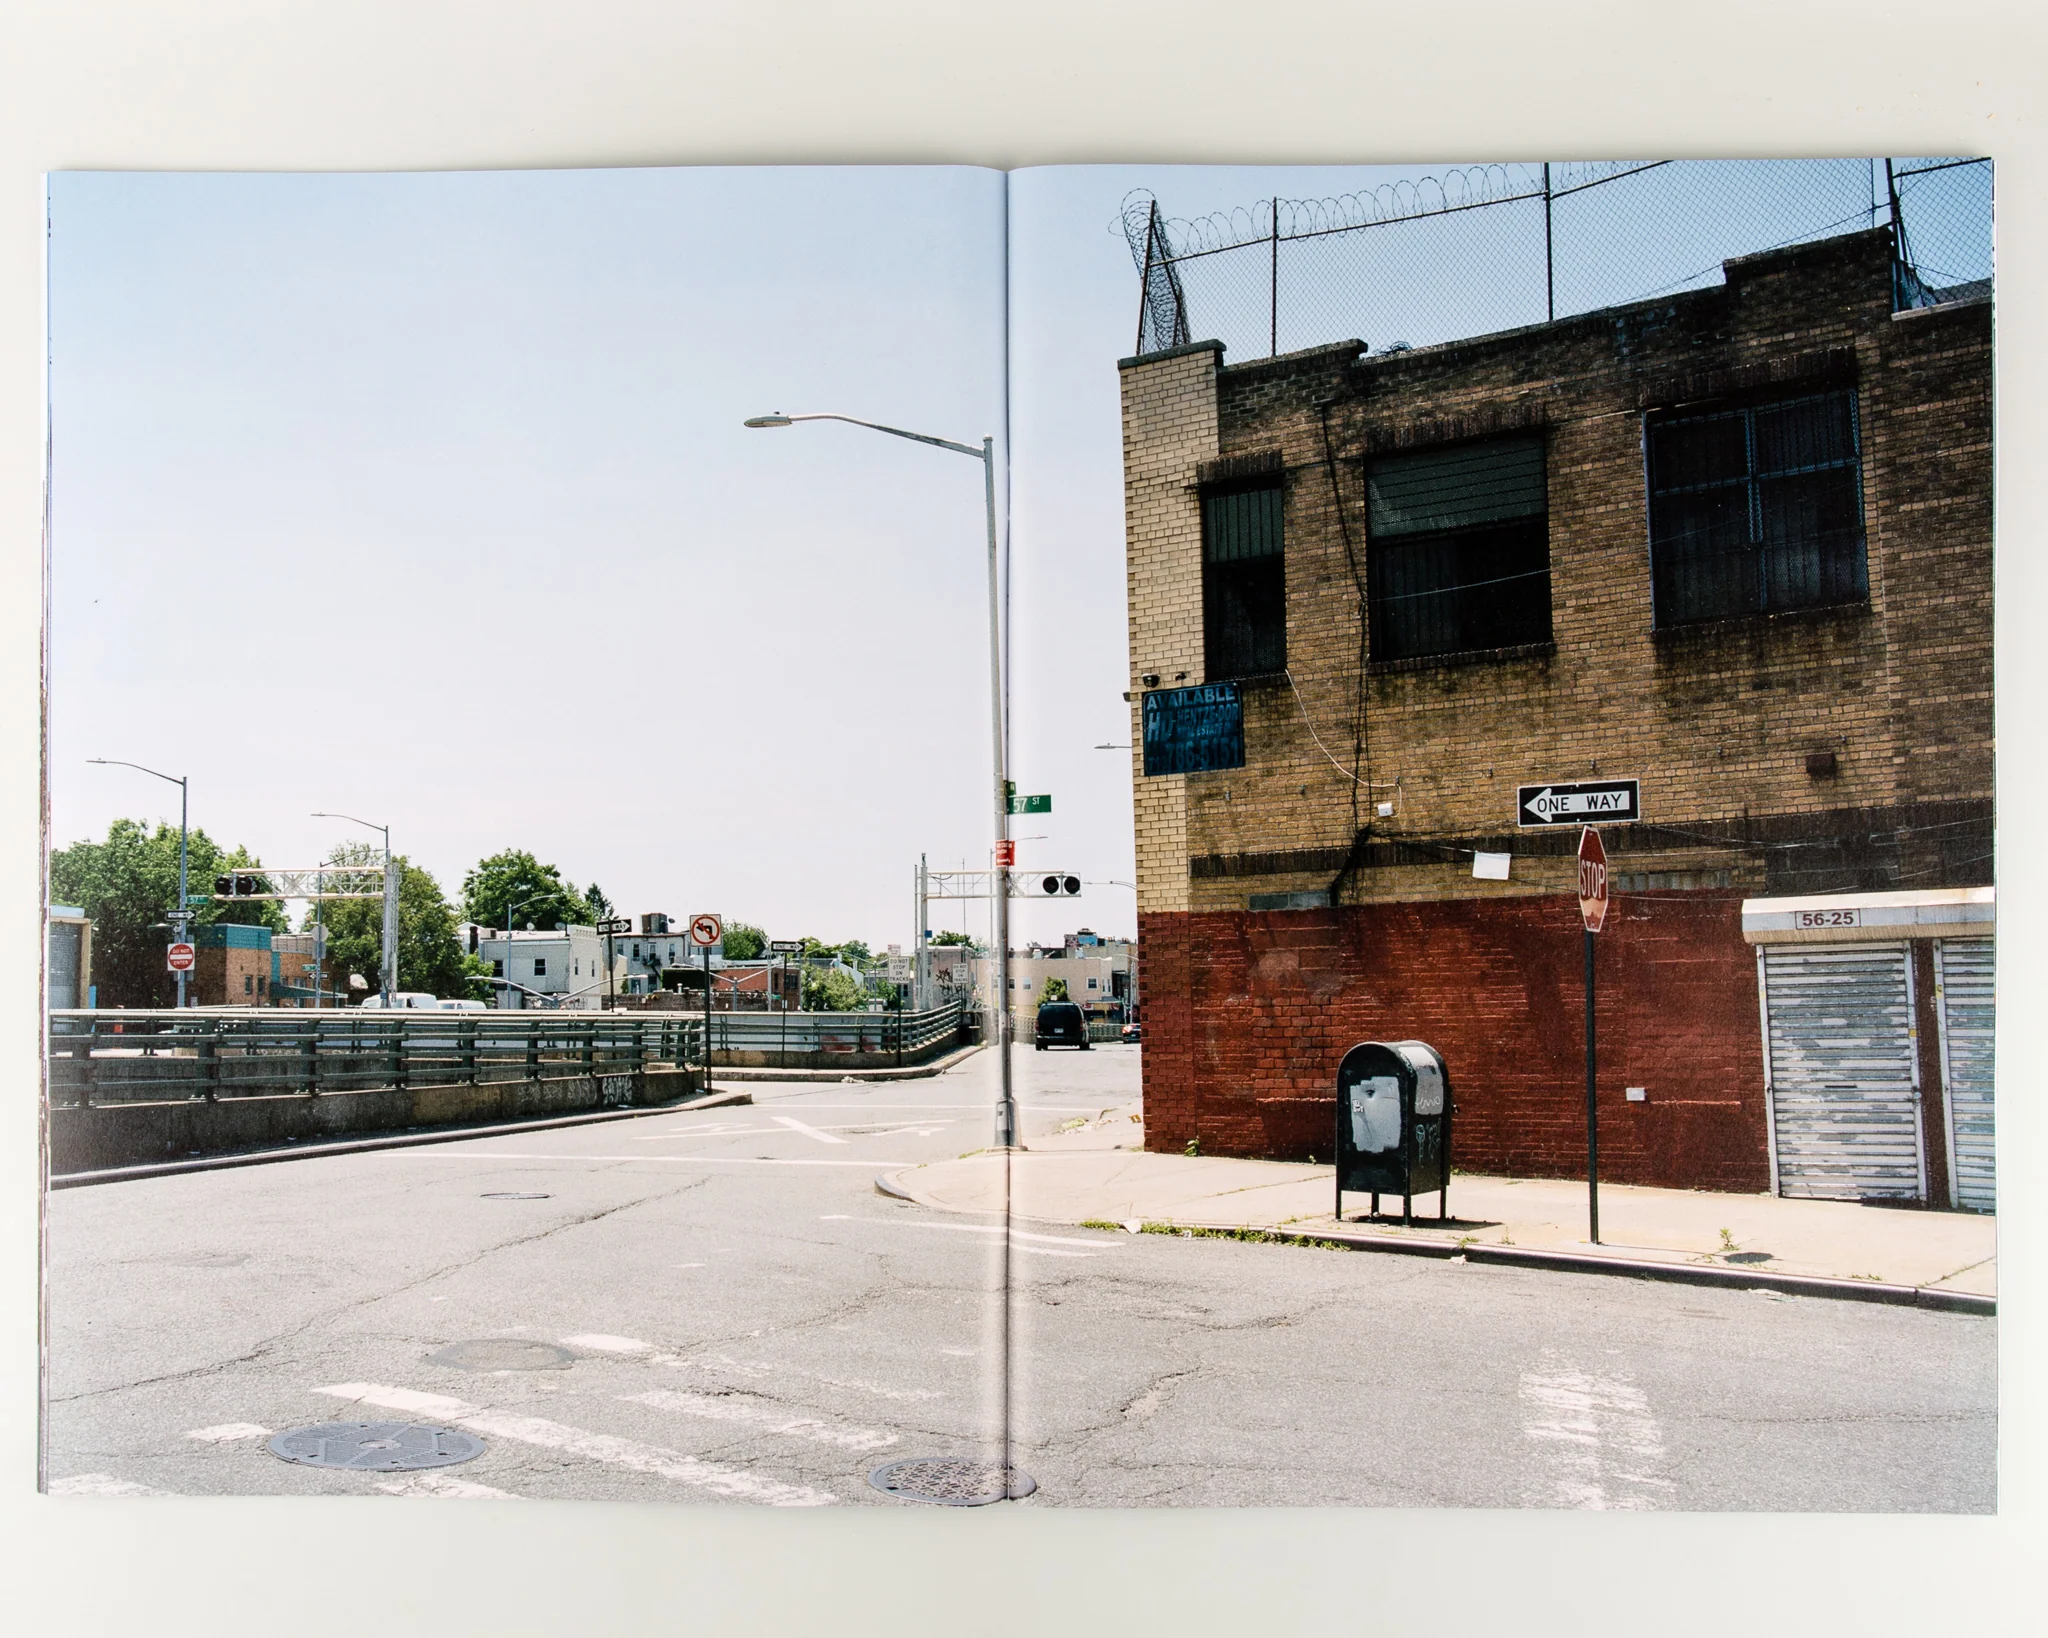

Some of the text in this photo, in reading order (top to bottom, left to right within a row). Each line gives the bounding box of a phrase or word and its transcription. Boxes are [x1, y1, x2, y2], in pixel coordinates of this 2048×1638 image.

[1147, 687, 1236, 710] AVAILABLE
[1196, 723, 1223, 737] ESTATE
[1013, 796, 1041, 813] 57 ST
[1537, 794, 1622, 813] ONE WAY
[1580, 859, 1606, 899] STOP
[1802, 911, 1854, 927] 56-25
